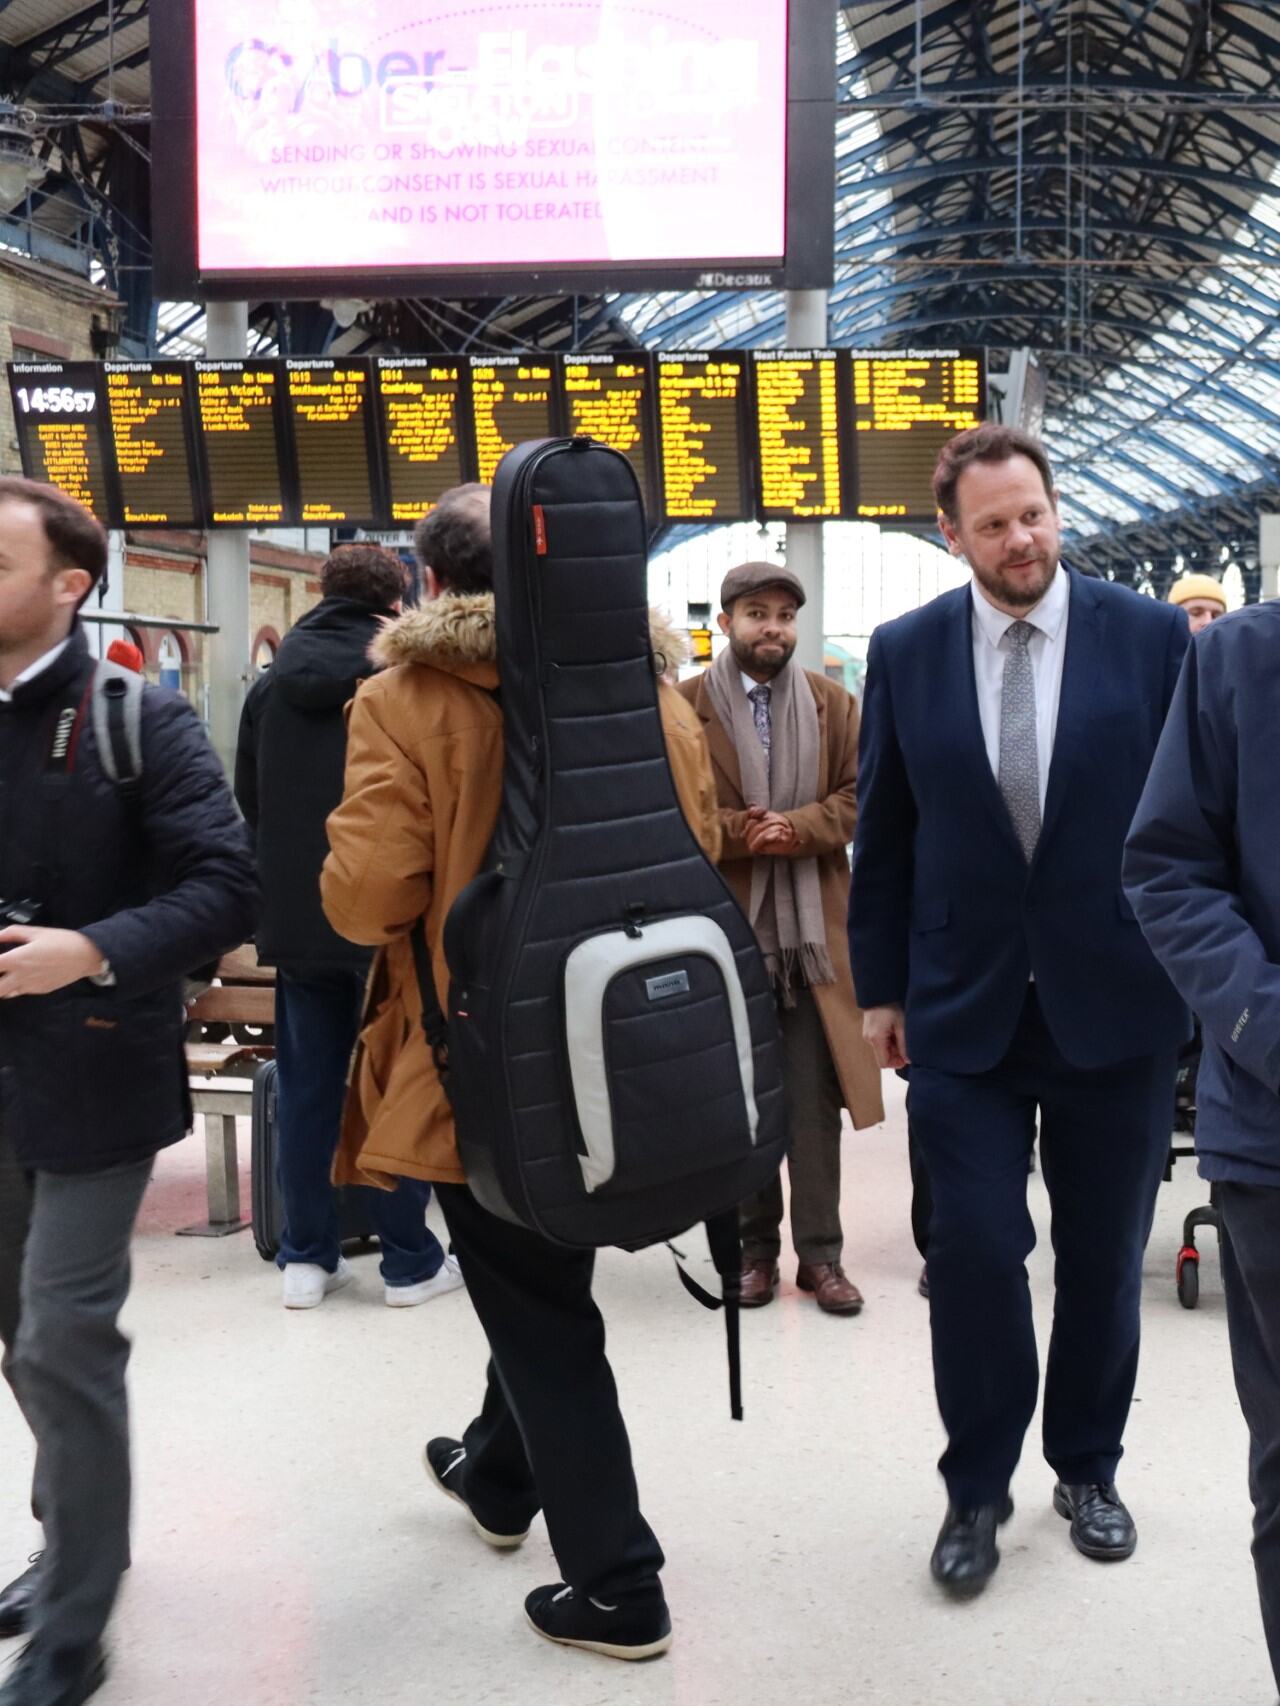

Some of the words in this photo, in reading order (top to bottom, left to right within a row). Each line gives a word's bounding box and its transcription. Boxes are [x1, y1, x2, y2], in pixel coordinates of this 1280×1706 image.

[271, 144, 366, 164] SENDING
[373, 143, 402, 161] OR
[410, 141, 518, 161] SHOWING
[525, 138, 597, 158] SEXUAL
[260, 176, 354, 194] WITHOUT
[362, 173, 462, 193] CONSENT
[469, 173, 486, 191] IS
[494, 171, 569, 190] SEXUAL
[368, 206, 413, 224] AND
[419, 205, 438, 223] IS
[445, 204, 488, 223] NOT
[564, 354, 614, 365] Departures
[658, 352, 709, 363] Departures
[753, 351, 776, 360] Next
[777, 351, 812, 361] Fastest
[813, 351, 837, 360] Train
[851, 349, 907, 360] Subsequent
[907, 349, 961, 359] Departures
[104, 362, 152, 372] Departures
[195, 362, 244, 371] Departures
[286, 359, 335, 370] Departures
[378, 357, 427, 368] Departures
[470, 356, 520, 367] Departures
[13, 363, 63, 373] Information
[199, 386, 229, 397] London
[230, 385, 264, 396] Victoria
[125, 513, 168, 522] Southern
